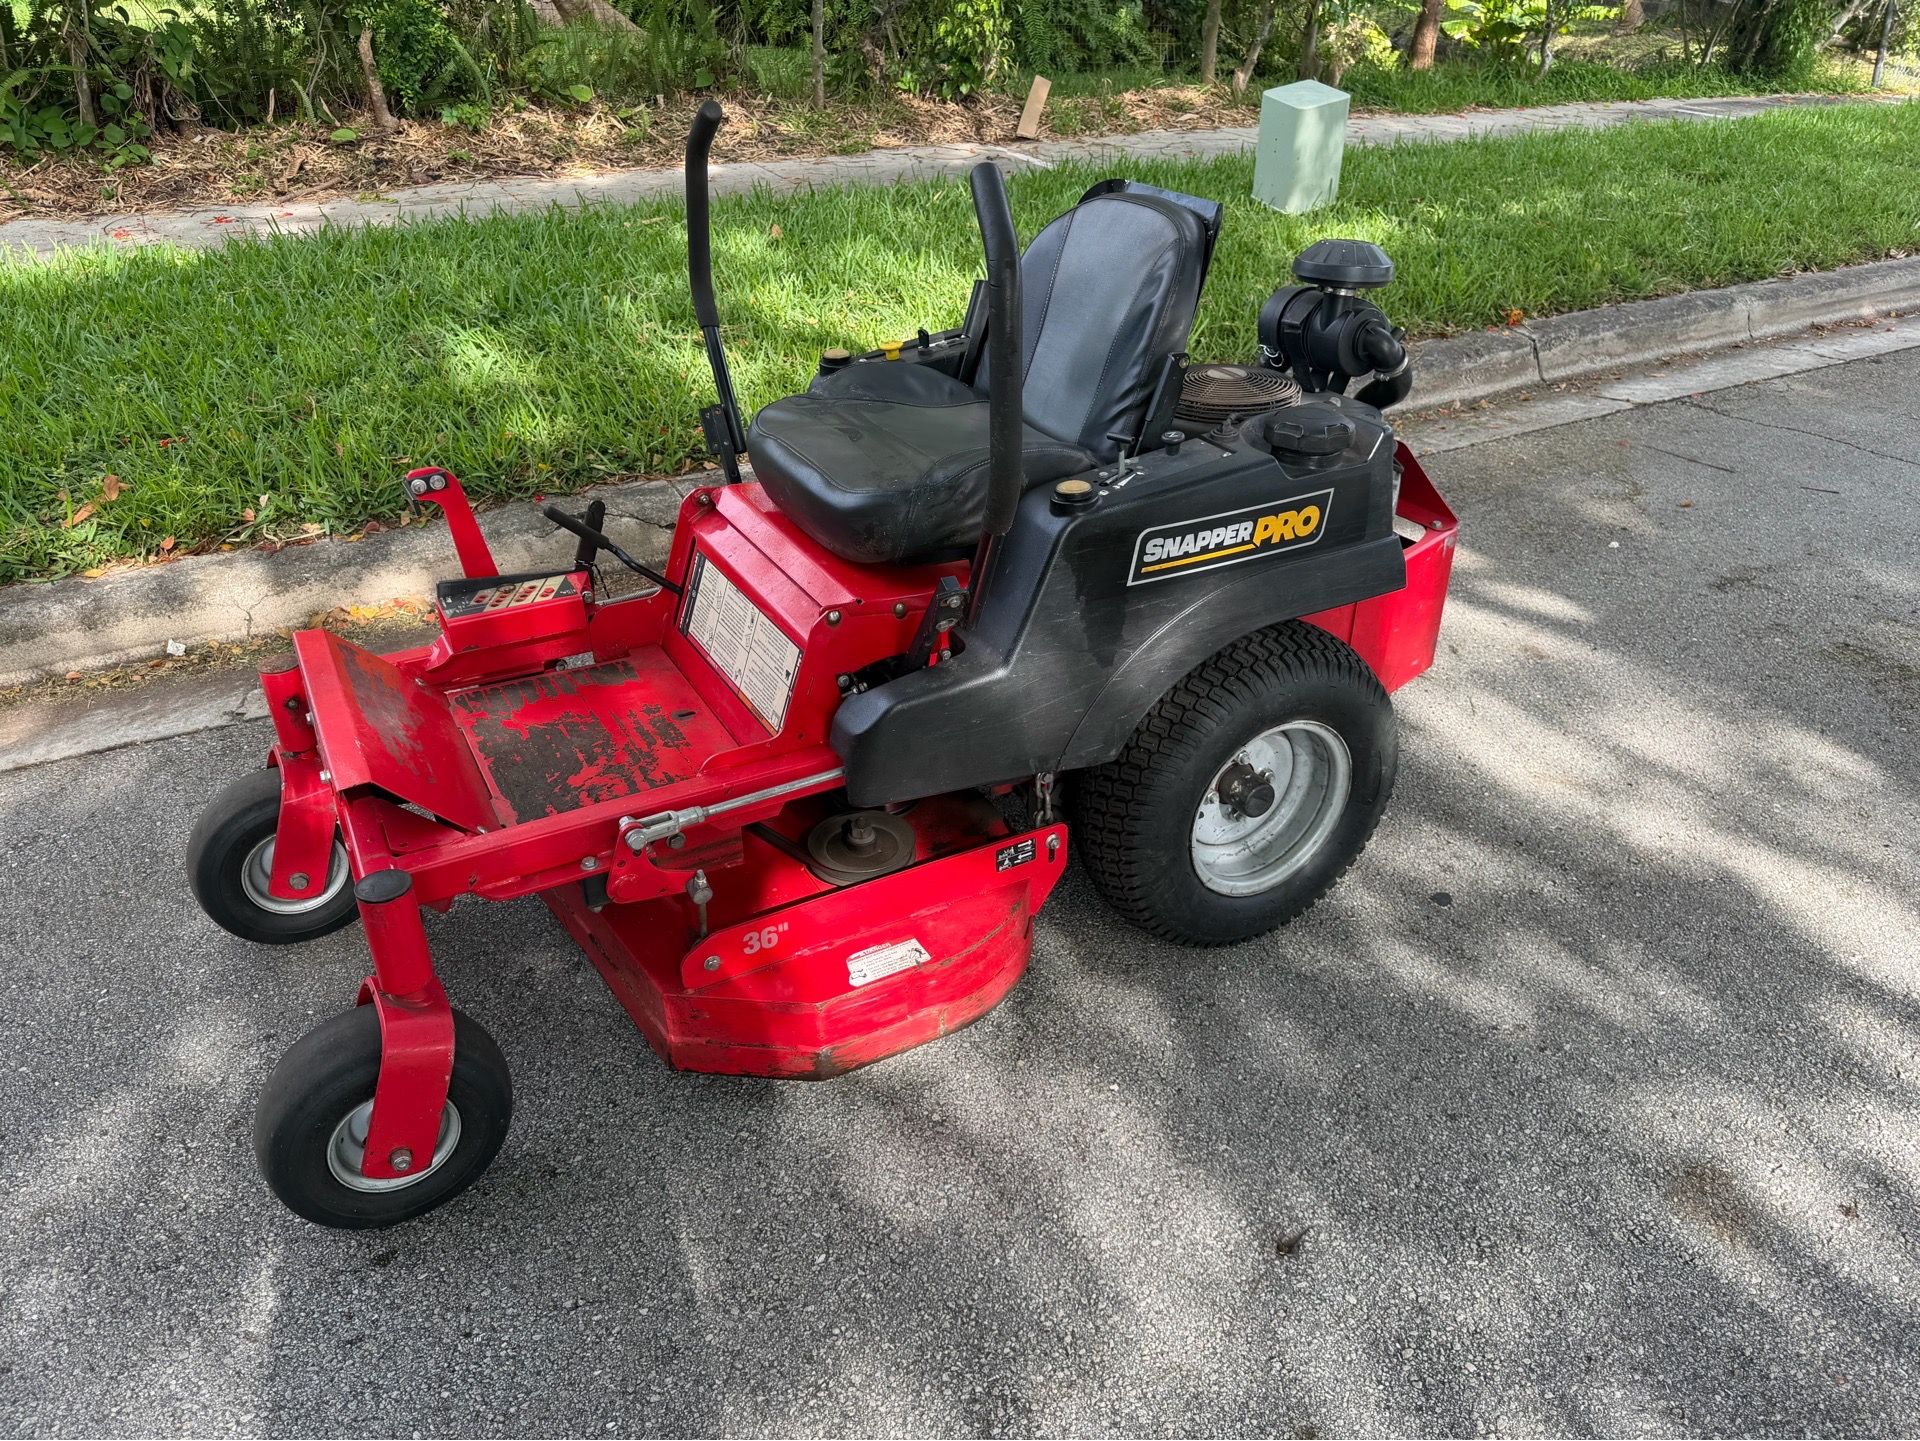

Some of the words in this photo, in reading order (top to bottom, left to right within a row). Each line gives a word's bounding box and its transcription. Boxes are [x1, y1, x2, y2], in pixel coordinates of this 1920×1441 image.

[1143, 520, 1254, 563] SNAPPER
[1252, 505, 1321, 547] PRO
[743, 921, 789, 955] 36"
